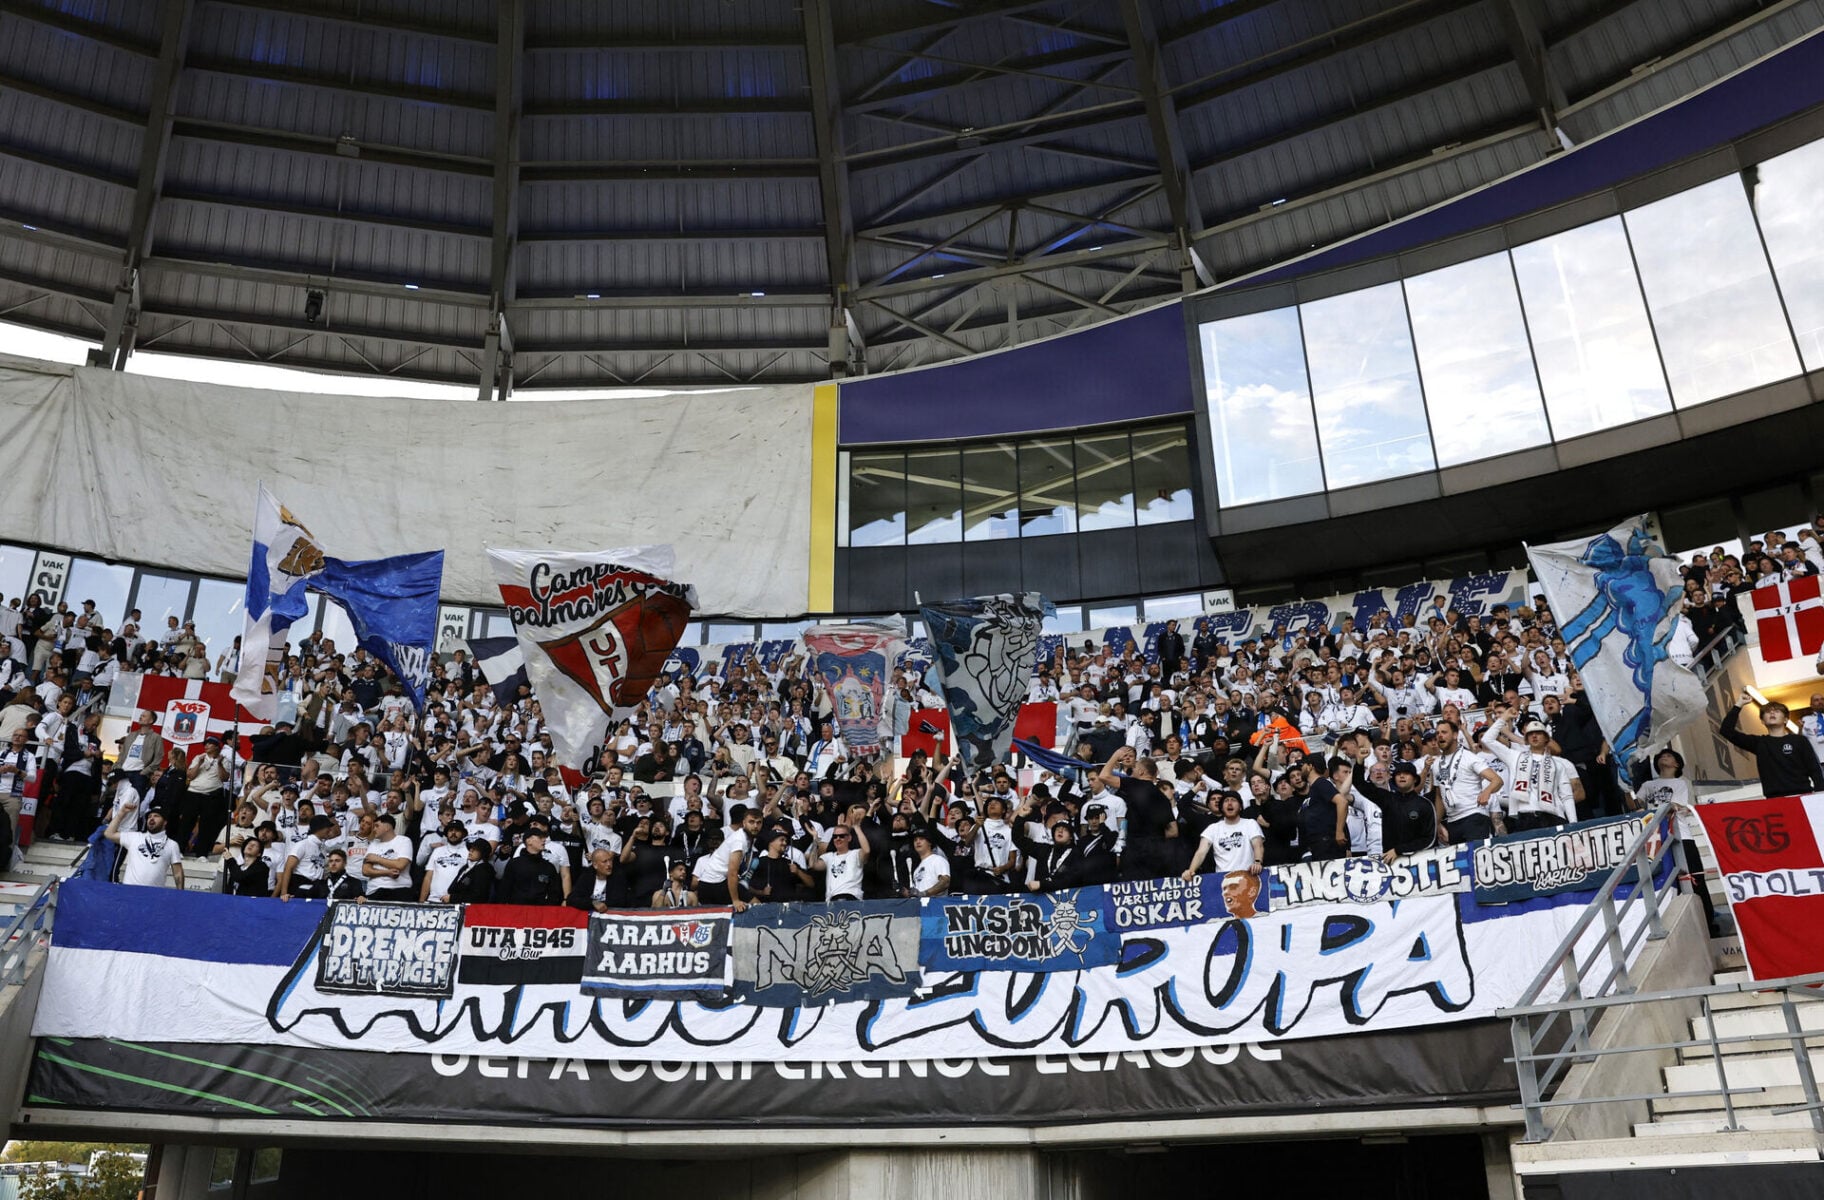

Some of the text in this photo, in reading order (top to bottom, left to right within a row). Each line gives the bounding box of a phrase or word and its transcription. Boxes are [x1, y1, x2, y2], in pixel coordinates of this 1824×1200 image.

[42, 559, 64, 570] VAK
[1208, 597, 1230, 607] VAK
[444, 613, 464, 622] VAK
[1111, 883, 1131, 896] DU
[1133, 879, 1158, 894] VIL
[1113, 886, 1202, 907] VÆRE MED OS
[335, 904, 458, 930] AARHUSIANSKE
[1114, 898, 1204, 928] OSKAR
[332, 924, 454, 963] DRENGE
[470, 927, 576, 949] UTA 1945
[600, 924, 676, 946] ARAD
[498, 945, 544, 960] On tour
[945, 934, 1052, 961] UNGDOM
[597, 951, 711, 975] AARHUS
